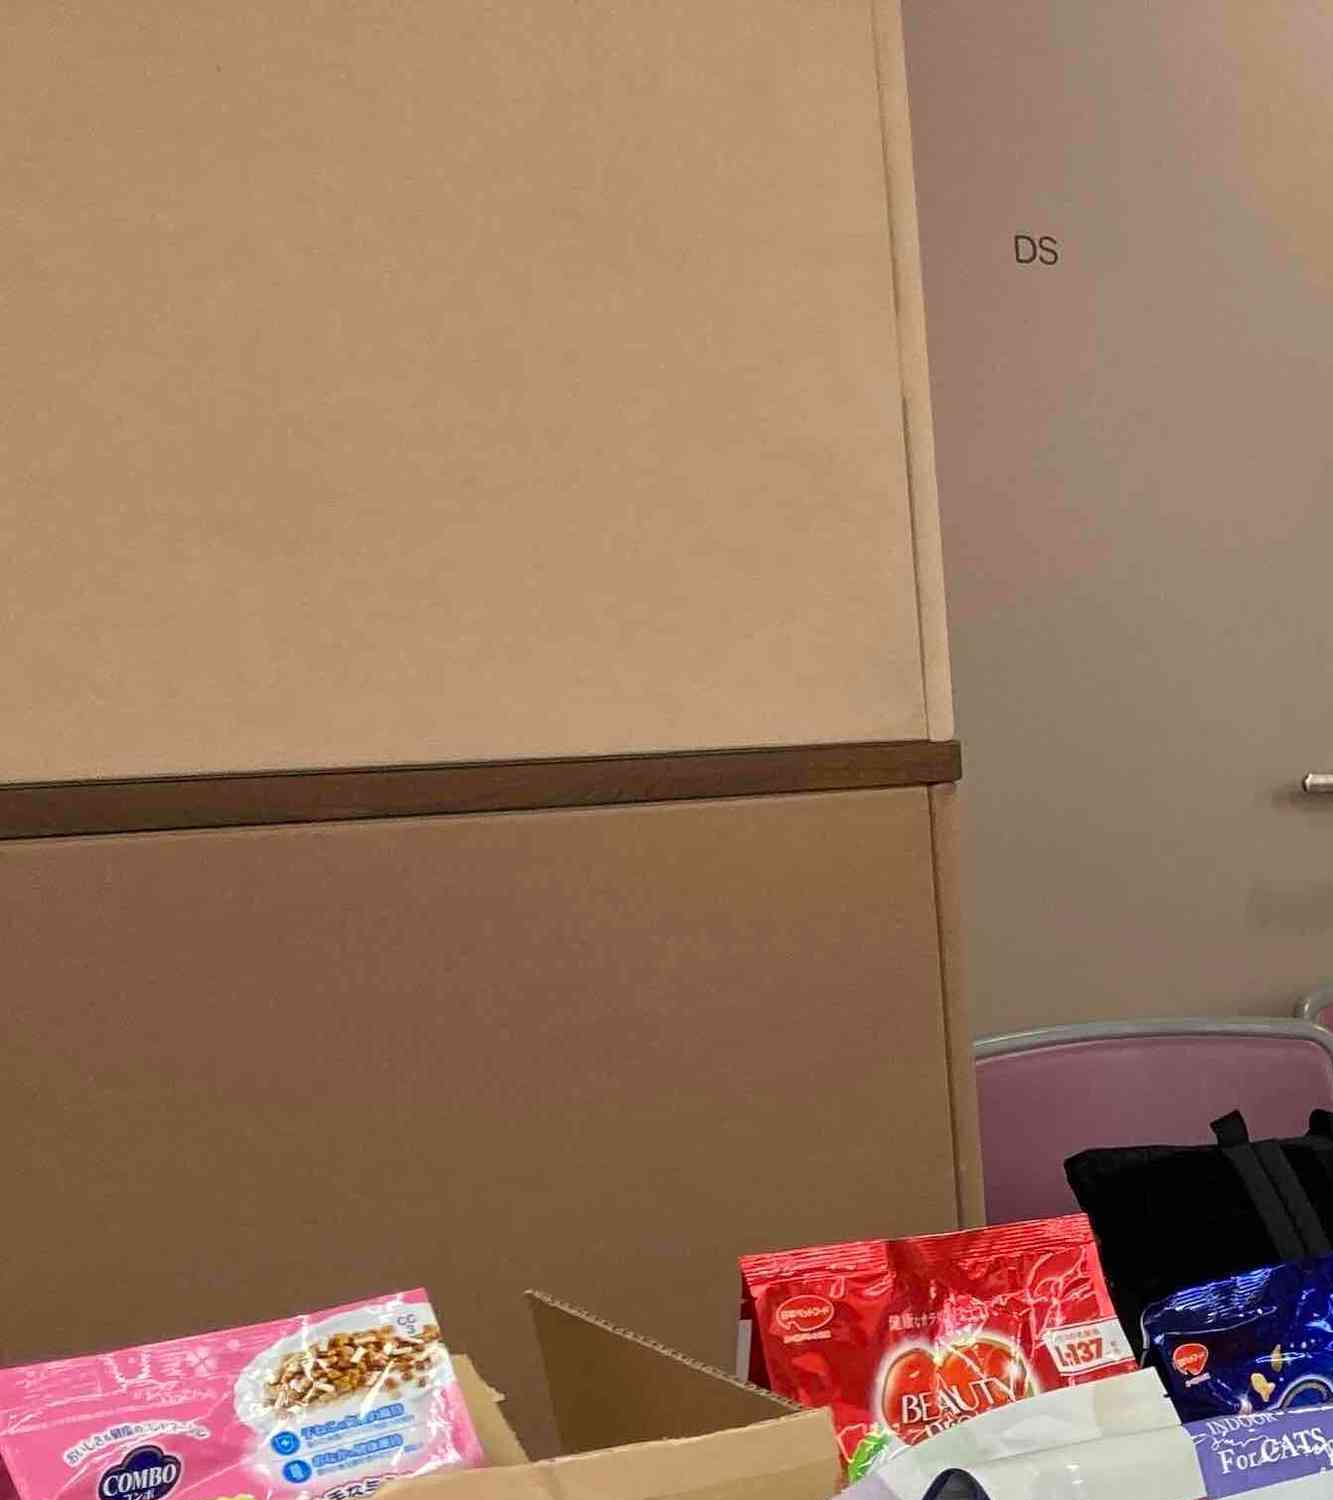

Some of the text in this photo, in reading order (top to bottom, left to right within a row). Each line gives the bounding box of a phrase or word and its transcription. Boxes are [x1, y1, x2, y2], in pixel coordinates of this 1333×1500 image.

[1014, 234, 1059, 266] DS
[901, 1374, 1018, 1424] BEAUTY
[101, 1462, 178, 1500] COMBO
